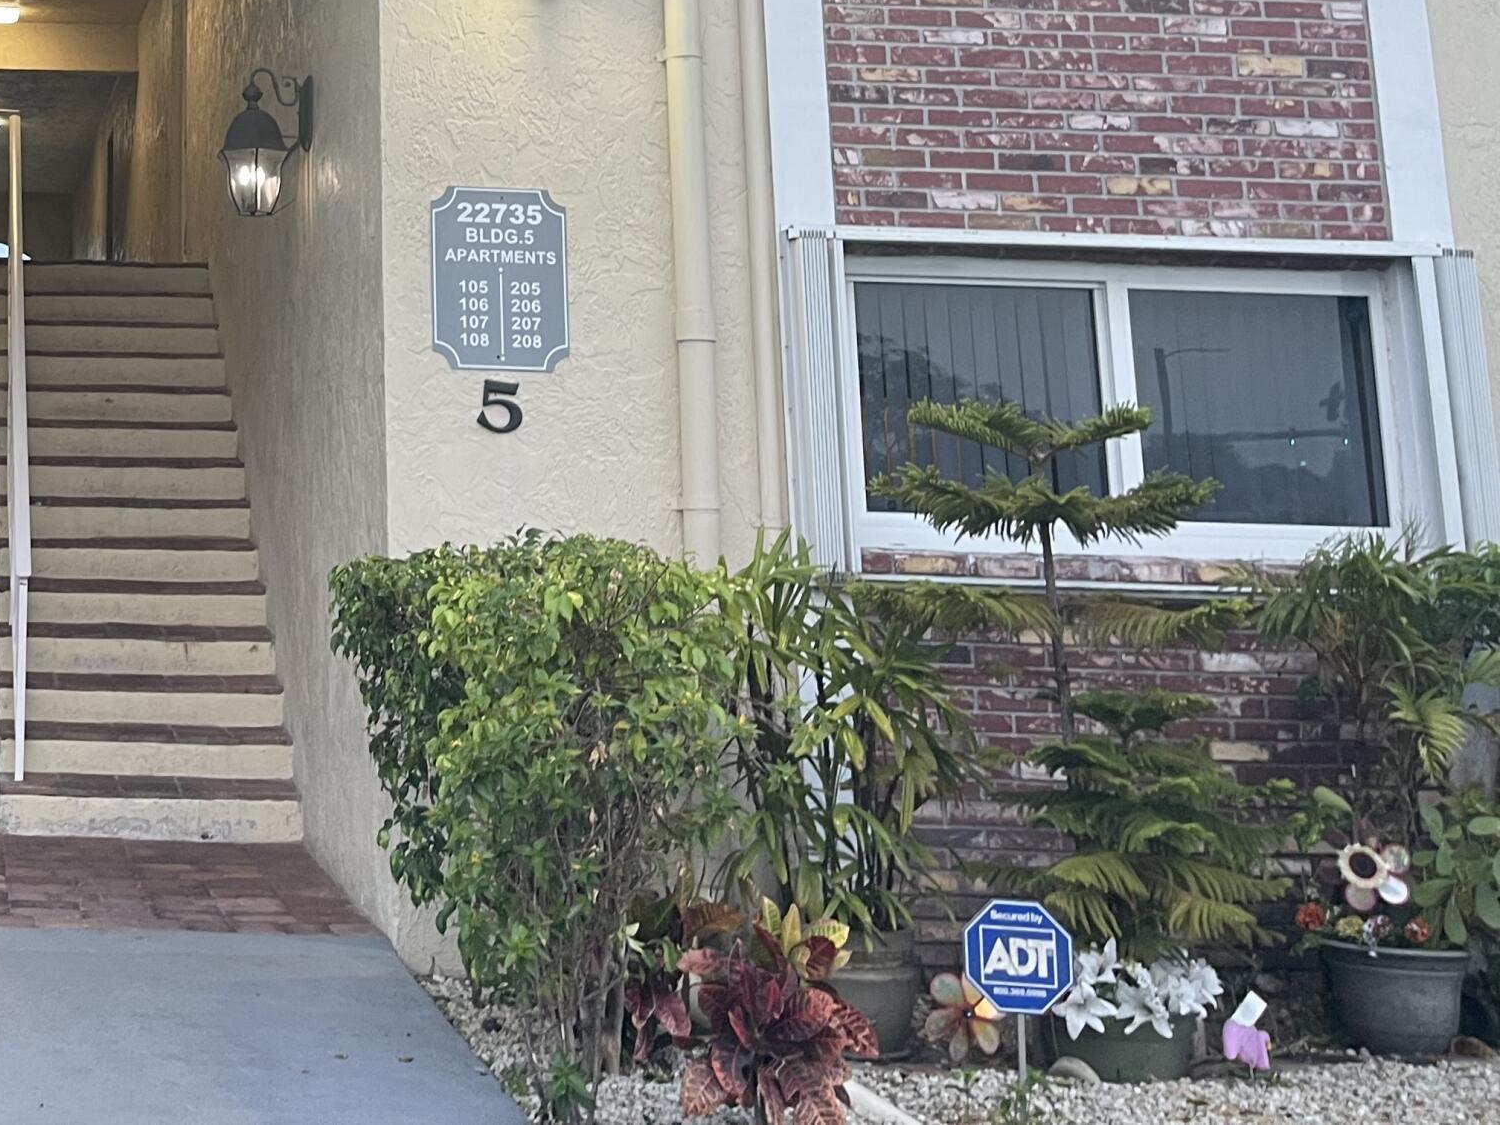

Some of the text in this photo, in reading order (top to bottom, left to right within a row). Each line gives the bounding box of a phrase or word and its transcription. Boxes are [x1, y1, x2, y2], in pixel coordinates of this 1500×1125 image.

[456, 201, 543, 225] 22735
[465, 227, 535, 245] BLDG.5
[444, 248, 557, 265] APARTMENTS
[458, 279, 489, 294] 105
[510, 281, 541, 296] 205
[459, 297, 489, 312] 106
[511, 299, 541, 313] 206
[459, 315, 489, 329] 107
[511, 317, 542, 331] 207
[460, 333, 490, 347] 108
[512, 334, 542, 348] 208
[476, 378, 523, 434] 5
[984, 937, 1055, 979] ADT
